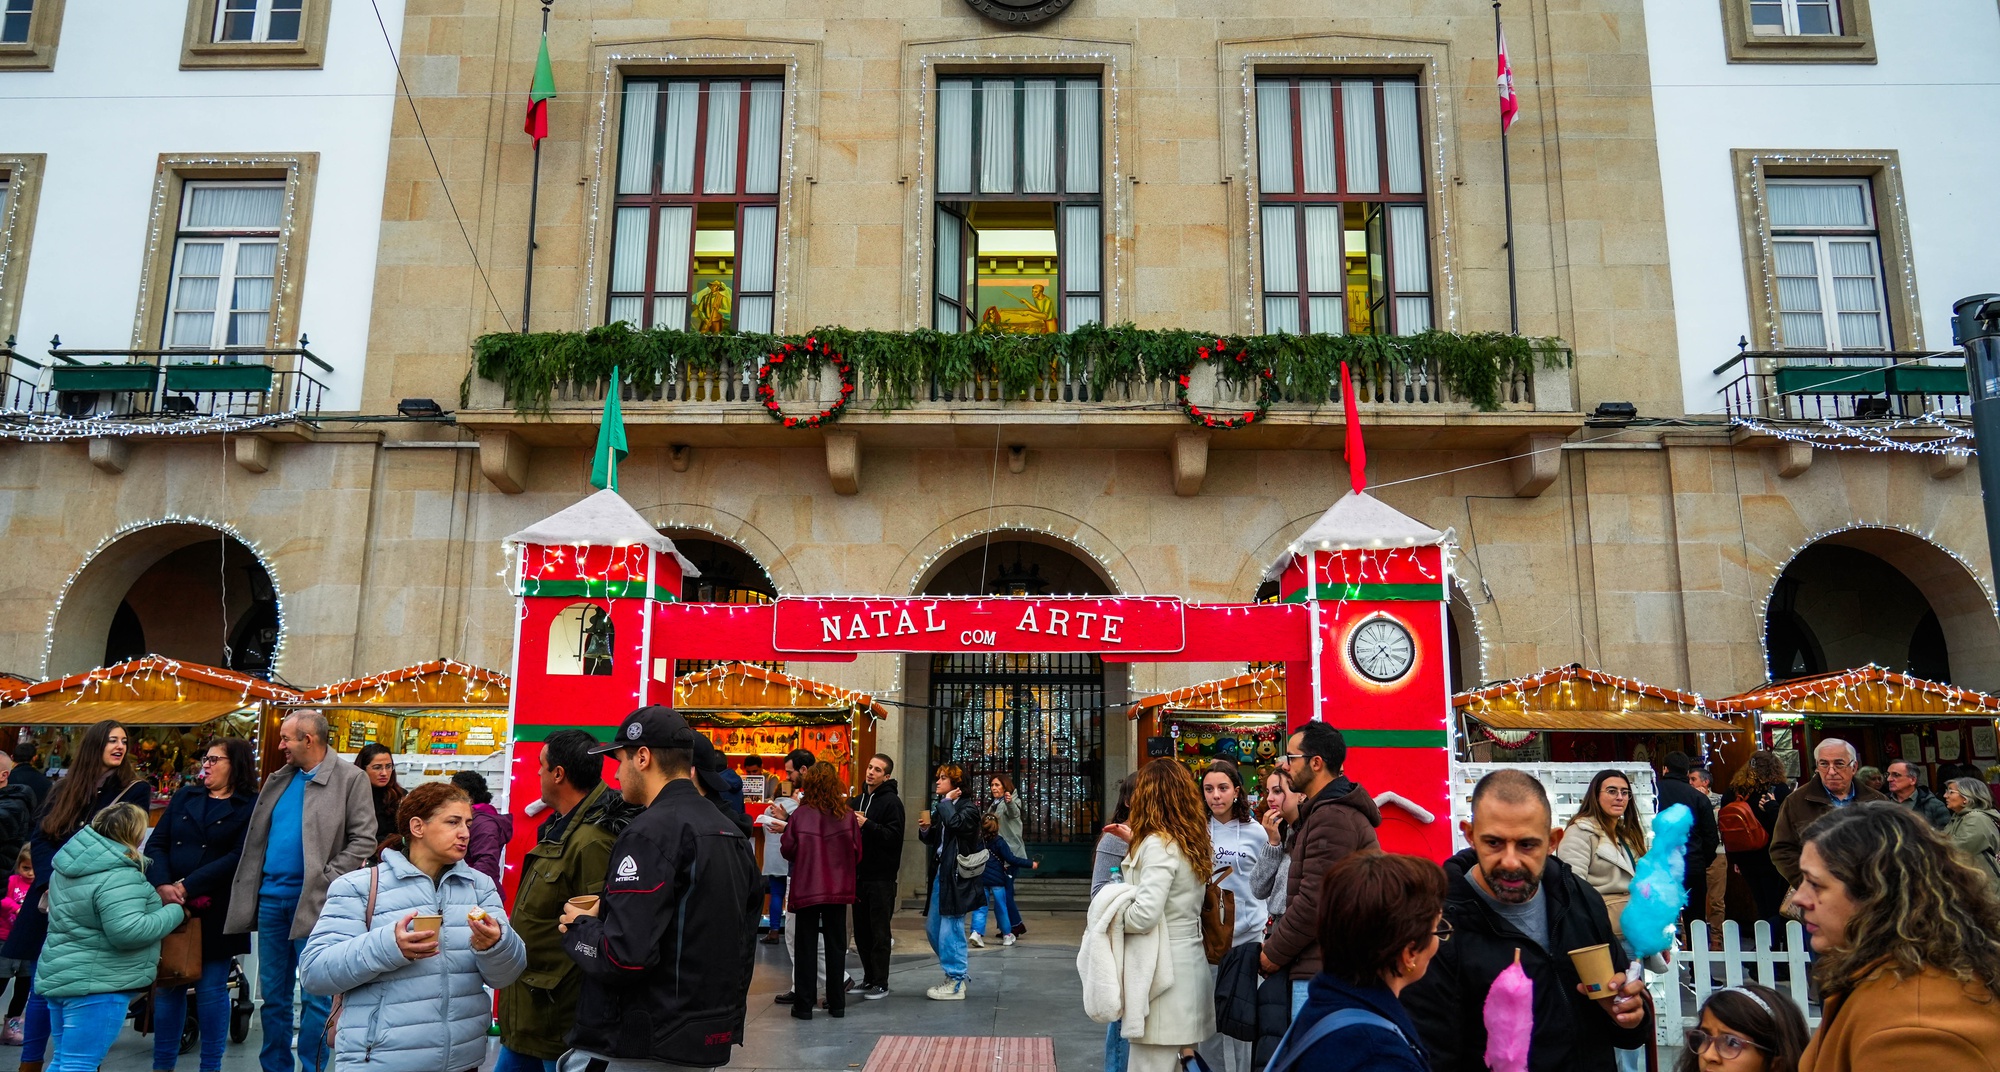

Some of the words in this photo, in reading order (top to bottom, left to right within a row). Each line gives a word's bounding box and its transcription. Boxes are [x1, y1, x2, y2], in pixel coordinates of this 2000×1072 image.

[1008, 11, 1030, 22] DA
[821, 606, 946, 642] NATAL
[960, 629, 996, 646] COM
[1016, 606, 1124, 643] ARTE
